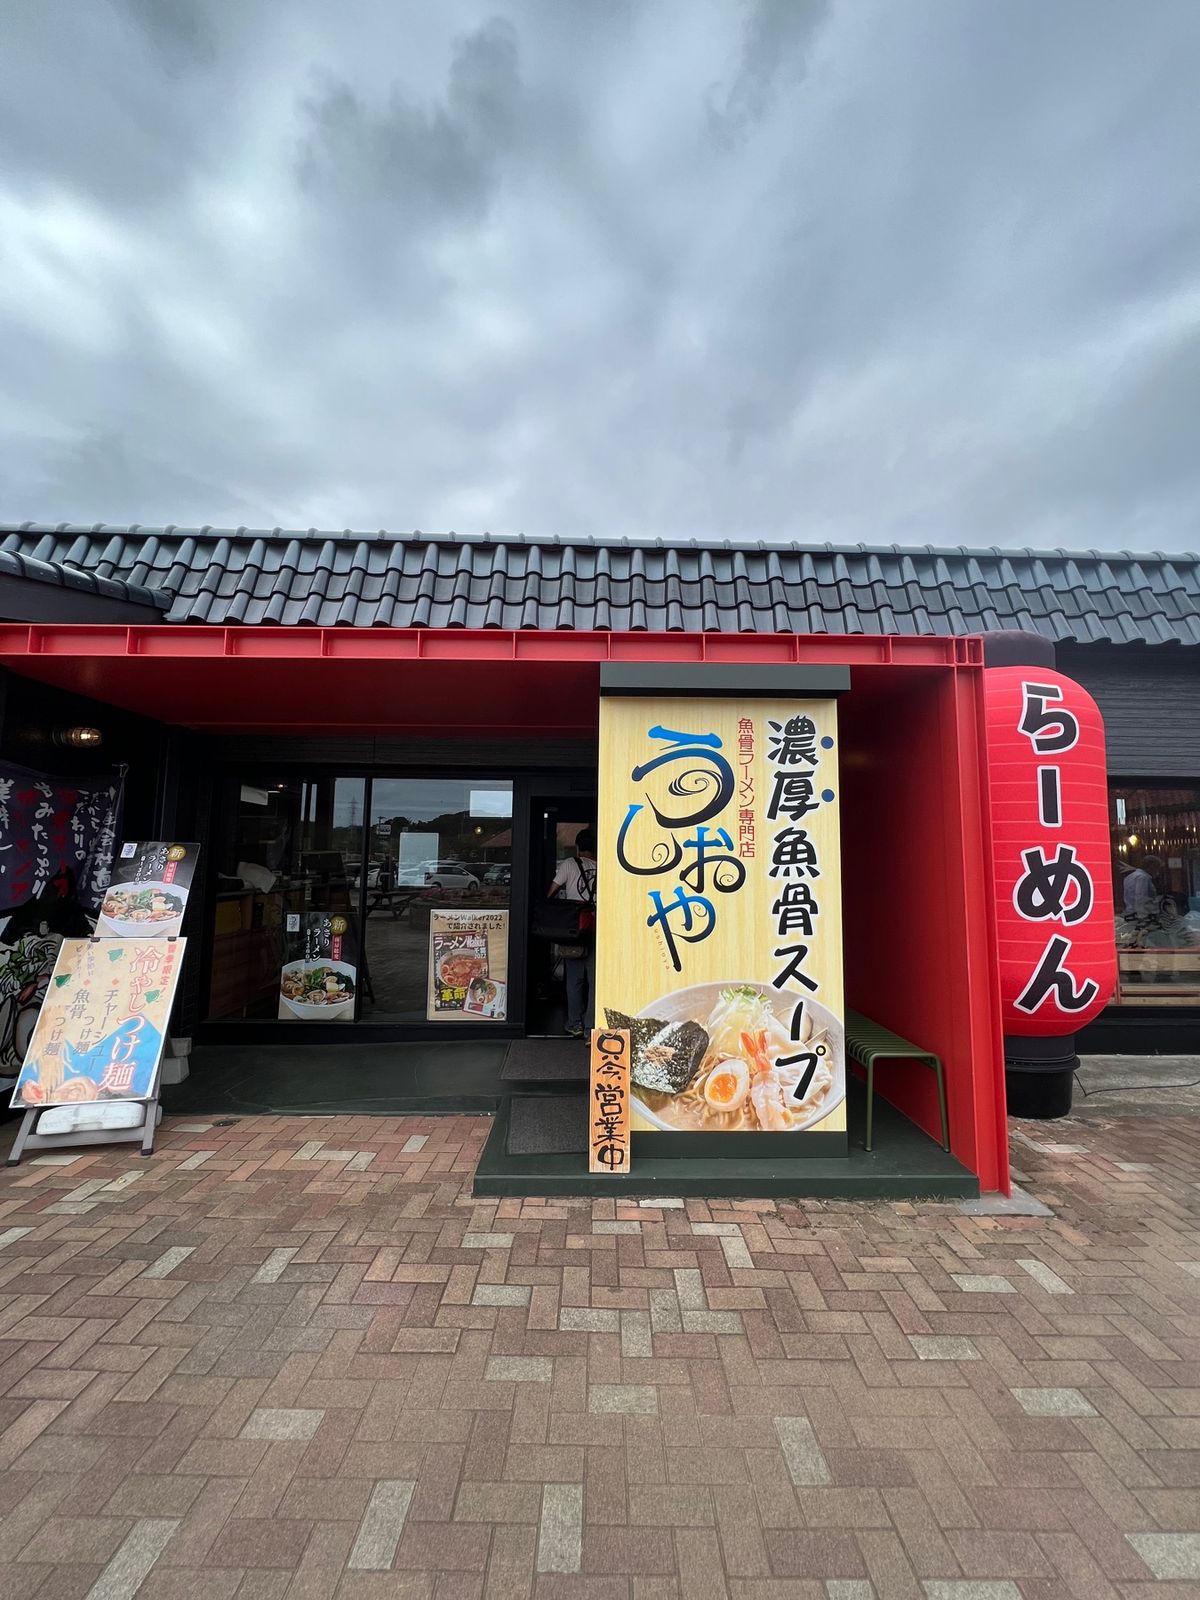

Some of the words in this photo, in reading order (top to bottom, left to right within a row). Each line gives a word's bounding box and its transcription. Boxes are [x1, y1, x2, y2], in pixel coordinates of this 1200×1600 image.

[738, 717, 756, 858] 魚骨ラーメン専門店
[1013, 681, 1100, 1013] らーめん
[141, 855, 157, 884] ラーメン
[767, 715, 821, 1102] 濃厚魚骨スープ
[311, 928, 321, 961] ラーメン
[323, 918, 332, 947] あさり
[70, 988, 89, 1020] 魚骨
[97, 945, 164, 1092] 冷やしつけ麺
[43, 1016, 66, 1056] つけ麺
[73, 1015, 95, 1055] つけ麺
[593, 1032, 627, 1171] 只今営業中
